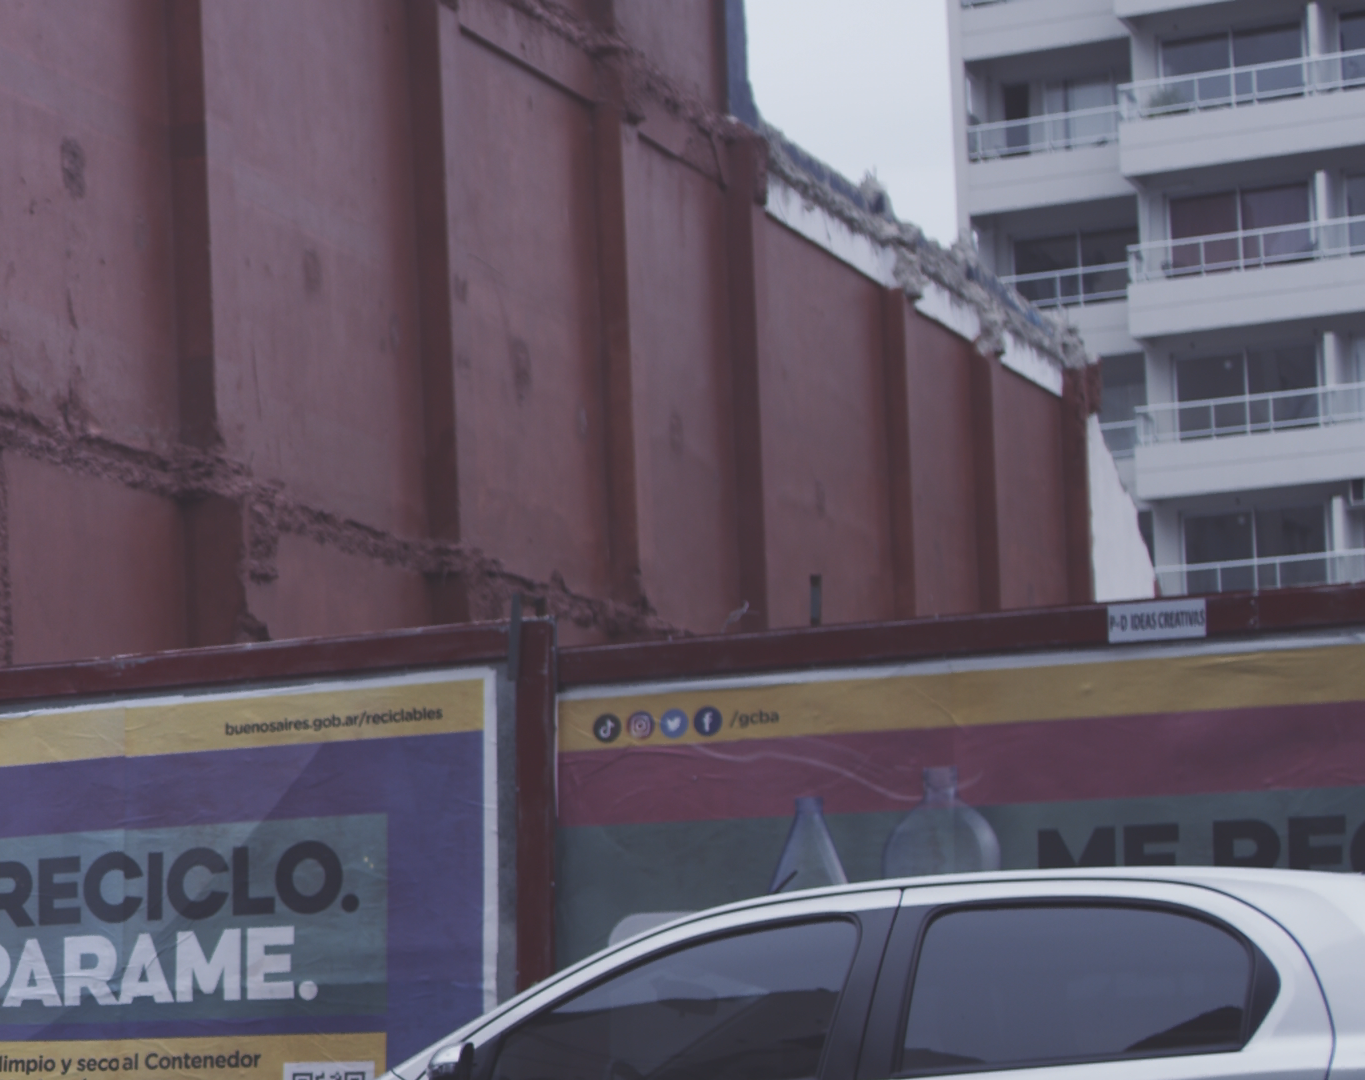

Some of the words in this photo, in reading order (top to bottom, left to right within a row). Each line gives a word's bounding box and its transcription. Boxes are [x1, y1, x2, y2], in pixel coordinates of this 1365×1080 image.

[1130, 612, 1156, 631] IDEAS
[1157, 608, 1205, 629] CREATIVAS
[225, 706, 444, 736] buenosaires.gob.ar/reciclables
[729, 709, 780, 729] /gcba
[61, 1058, 72, 1075] y
[77, 1056, 119, 1072] seco
[122, 1053, 139, 1071] al
[145, 1050, 261, 1070] Contenedor
